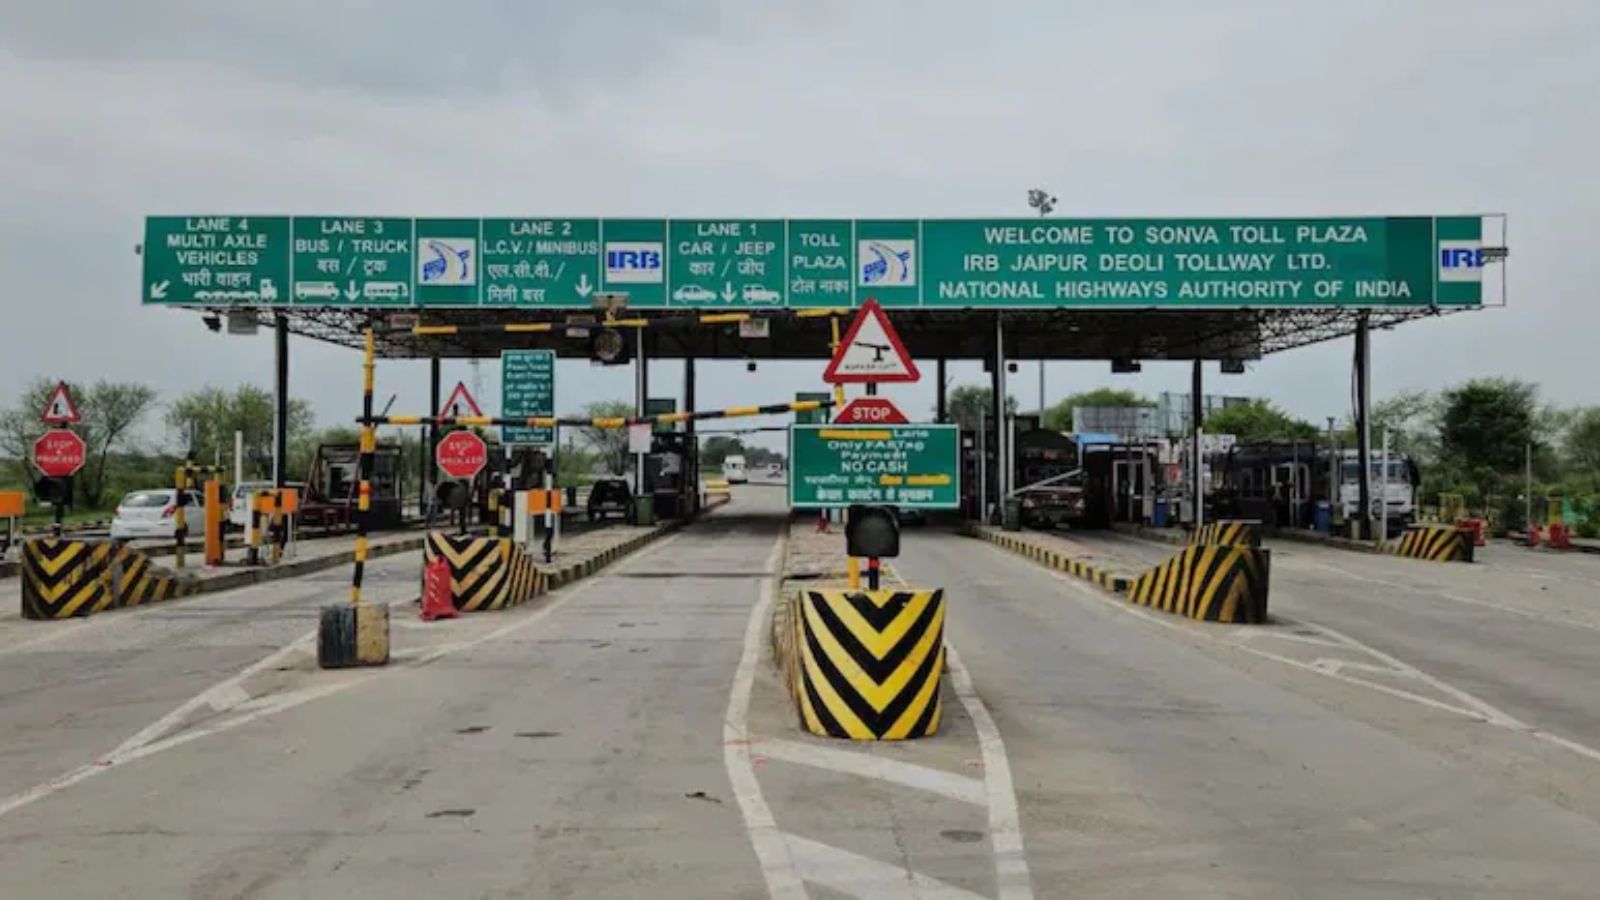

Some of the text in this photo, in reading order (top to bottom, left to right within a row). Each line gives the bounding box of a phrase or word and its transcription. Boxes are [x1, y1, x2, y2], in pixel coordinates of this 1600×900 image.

[186, 216, 248, 231] LANE 4
[321, 220, 383, 234] LANE 3
[510, 221, 571, 236] LANE 2
[697, 222, 756, 237] LANE 1
[167, 233, 266, 249] MULTI AXLE
[800, 233, 840, 247] TOLL
[984, 225, 1368, 245] WELCOME TO SONVA TOLL PLAZA
[295, 238, 408, 253] BUS / TRUCK
[535, 240, 599, 255] MINIBUS
[678, 241, 713, 255] CAR
[734, 241, 775, 256] JEEP
[176, 250, 258, 266] VEHICLES
[317, 259, 340, 273] बस
[346, 256, 357, 275] /
[608, 251, 660, 269] IRB
[793, 255, 846, 269] PLAZA
[963, 253, 1331, 272] IRB JAIPUR DEOLI TOLLWAY LTD.
[689, 257, 765, 277] कार / जीप
[181, 267, 252, 288] भारी वाहन
[791, 277, 816, 293] टोल
[487, 284, 545, 302] मिनी बस
[939, 280, 1411, 299] NATIONAL HIGHWAYS AUTHORITY OF INDIA
[852, 407, 891, 420] STOP
[893, 430, 930, 438] Lane
[827, 441, 864, 451] Only
[841, 461, 908, 472] NO CASH
